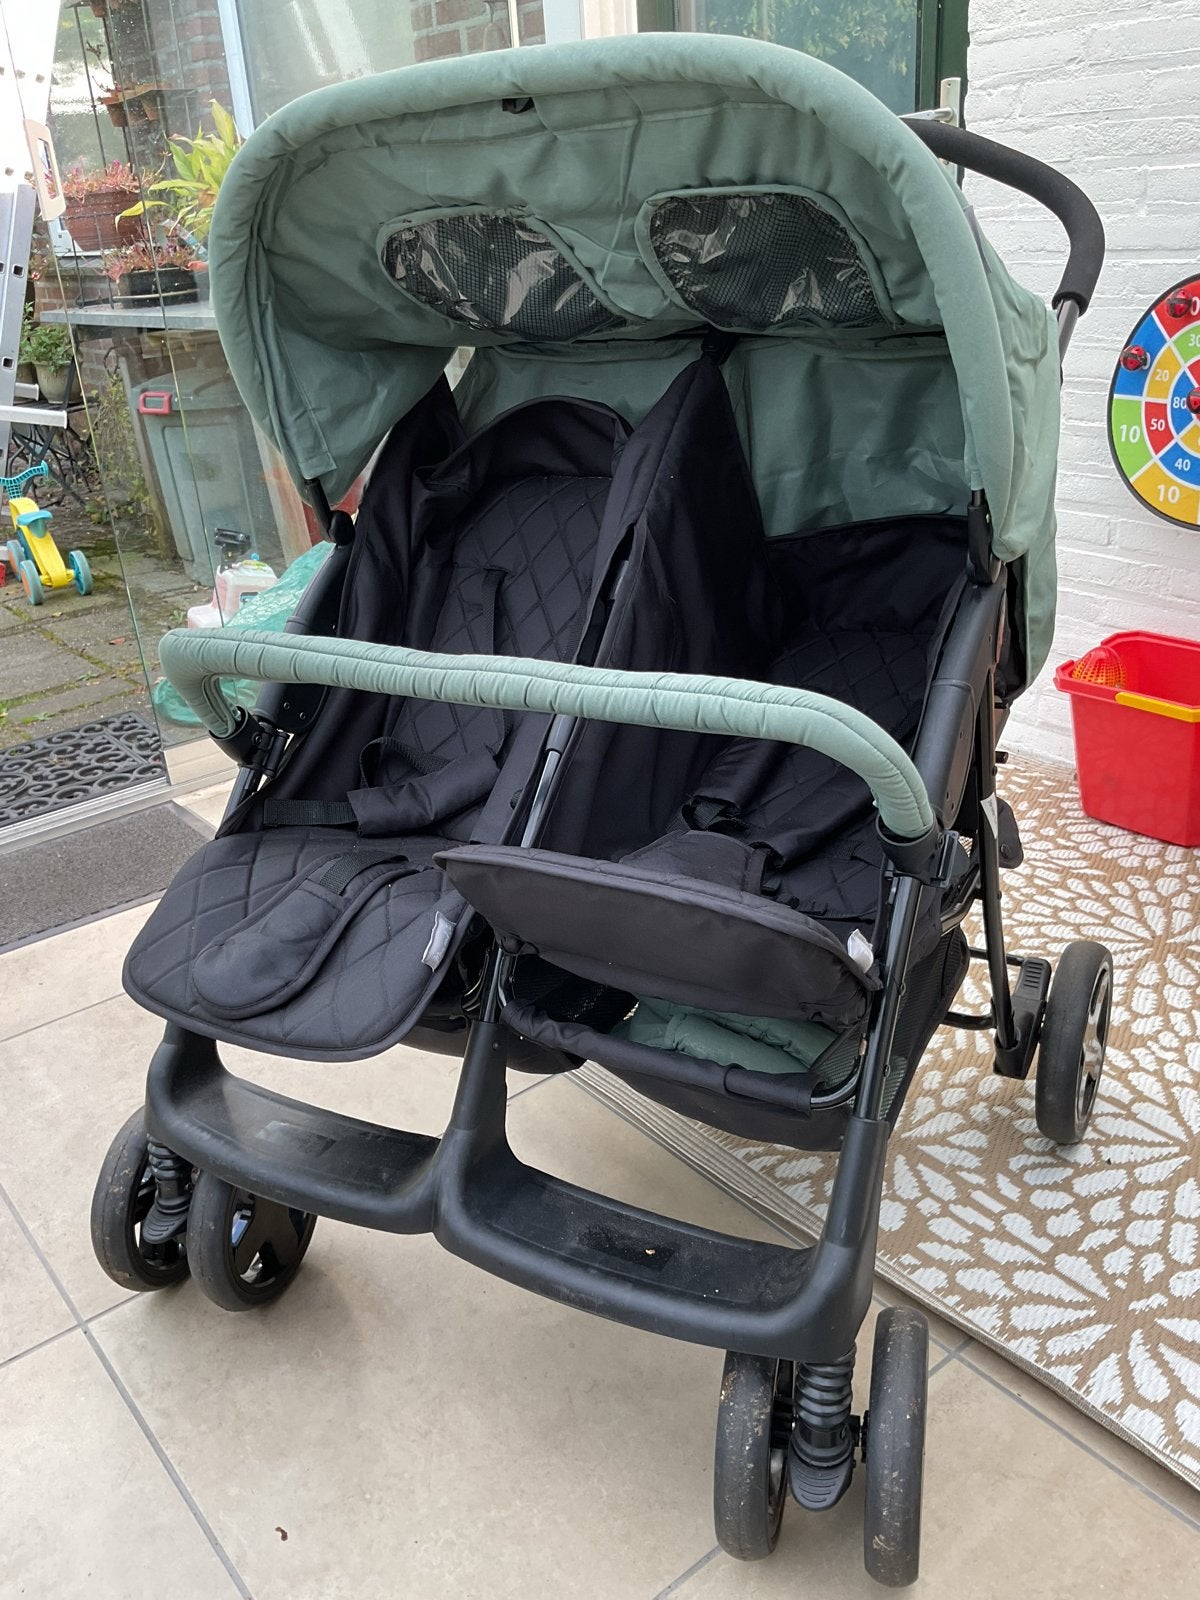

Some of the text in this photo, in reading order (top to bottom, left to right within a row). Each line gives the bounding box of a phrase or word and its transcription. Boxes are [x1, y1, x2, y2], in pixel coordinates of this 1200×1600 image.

[1155, 369, 1169, 382] 20
[1172, 396, 1187, 410] 80
[1149, 418, 1165, 431] 50
[1120, 424, 1140, 443] 10
[1174, 458, 1191, 471] 40
[1157, 484, 1180, 503] 10
